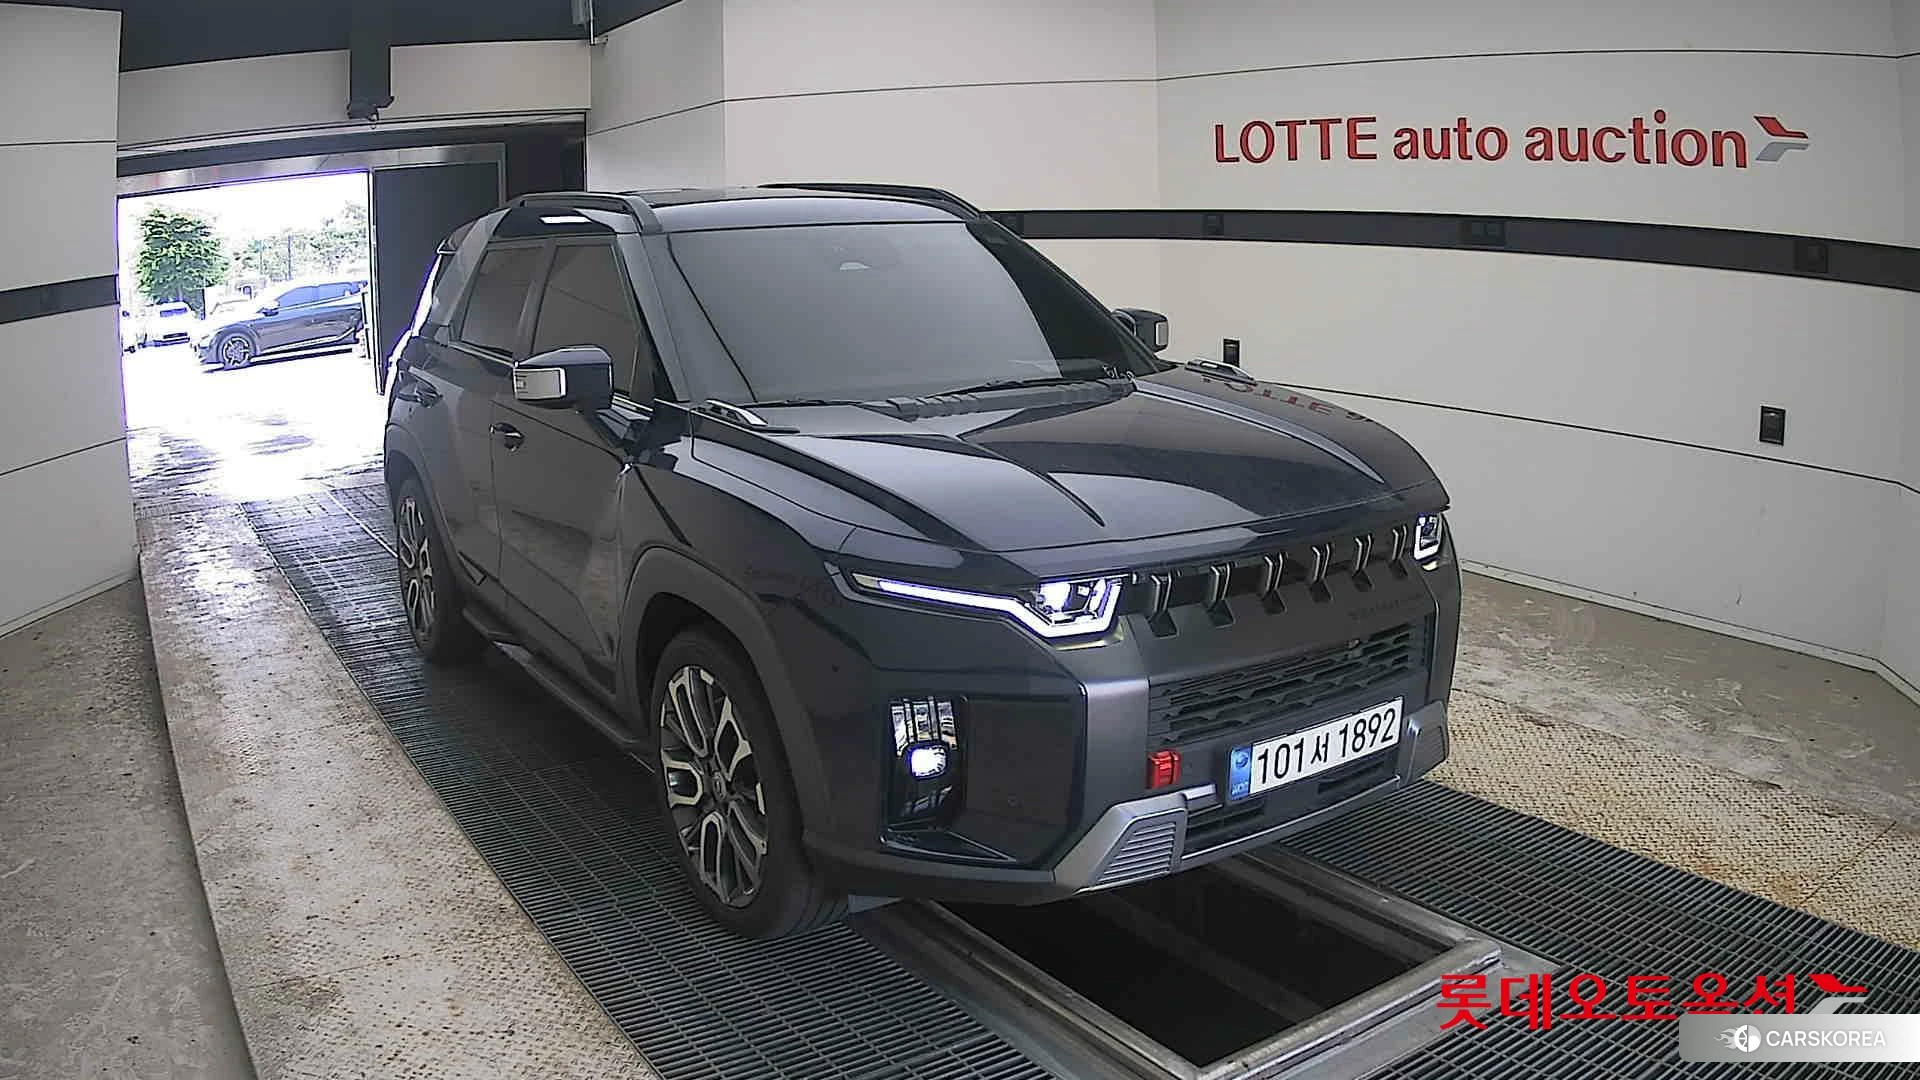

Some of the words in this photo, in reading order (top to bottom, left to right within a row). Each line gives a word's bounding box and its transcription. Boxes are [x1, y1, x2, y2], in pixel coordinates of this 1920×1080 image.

[1215, 116, 1377, 163] LOTTE
[1393, 117, 1509, 161] auto
[1524, 110, 1747, 169] auction
[1339, 708, 1396, 758] 1892
